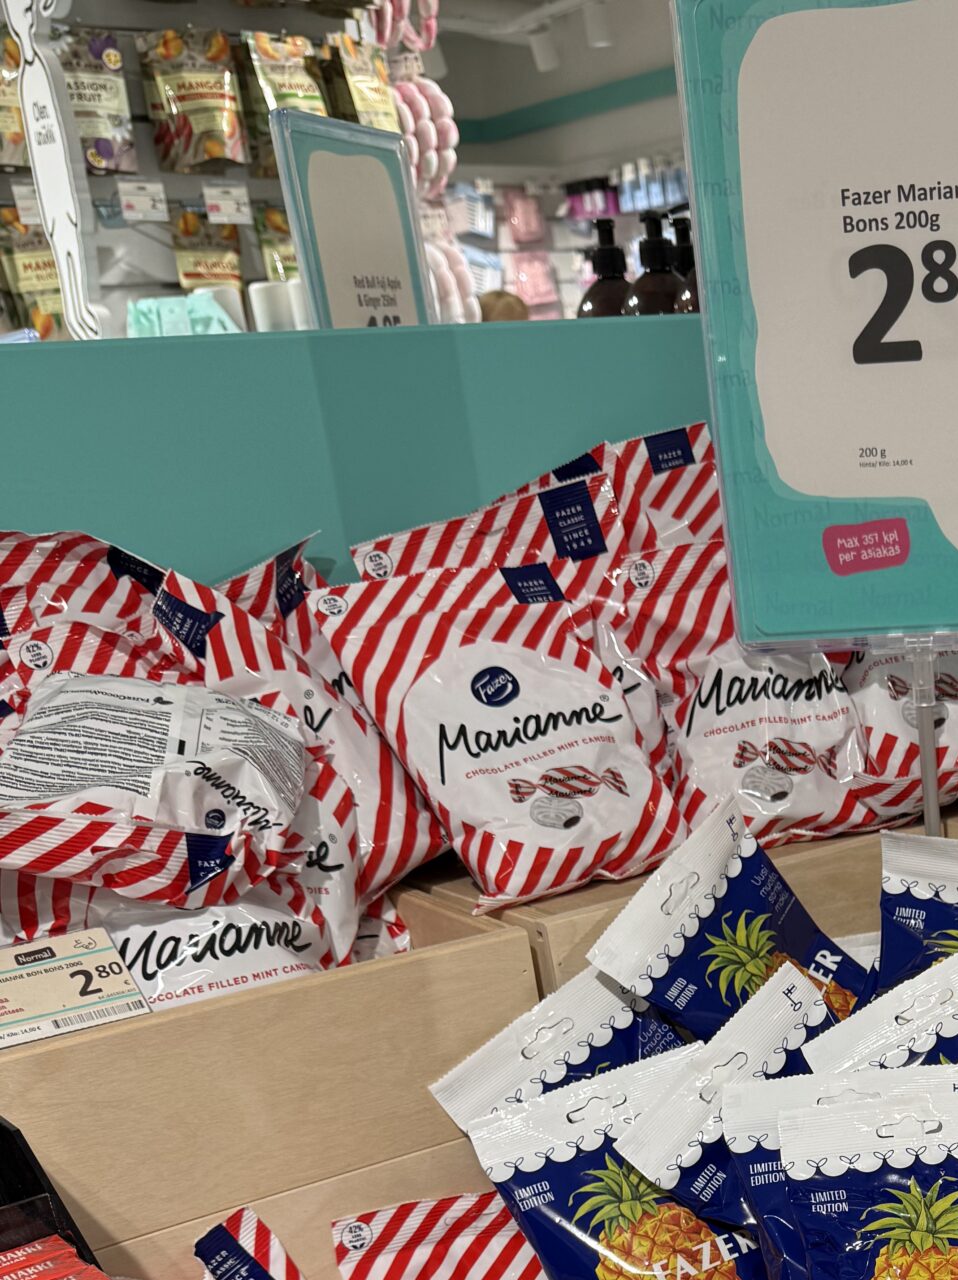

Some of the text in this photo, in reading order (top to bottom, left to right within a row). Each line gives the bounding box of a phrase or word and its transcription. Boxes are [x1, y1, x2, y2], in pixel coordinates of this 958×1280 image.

[177, 81, 223, 92] MANGO
[840, 188, 892, 207] Fazer
[842, 210, 940, 233] Bons 200g
[554, 504, 583, 518] FAZER
[558, 515, 585, 528] CLASSIC
[563, 529, 590, 543] SINCE
[837, 529, 899, 549] Max 357 kpl
[838, 545, 901, 565] per asiakas
[438, 701, 623, 786] Marianne
[465, 735, 616, 780] CHOCOLATE FILLED MINT CANDIES
[895, 906, 926, 920] LIMITED
[17, 950, 52, 964] Normal
[665, 977, 688, 1004] LIMITED
[675, 984, 699, 1011] EDITION
[690, 1163, 717, 1195] LIMITED
[699, 1170, 727, 1202] EDITION
[750, 1172, 786, 1187] EDITION
[513, 1180, 550, 1201] LIMITED
[810, 1189, 847, 1204] LIMITED
[519, 1191, 555, 1212] EDITION
